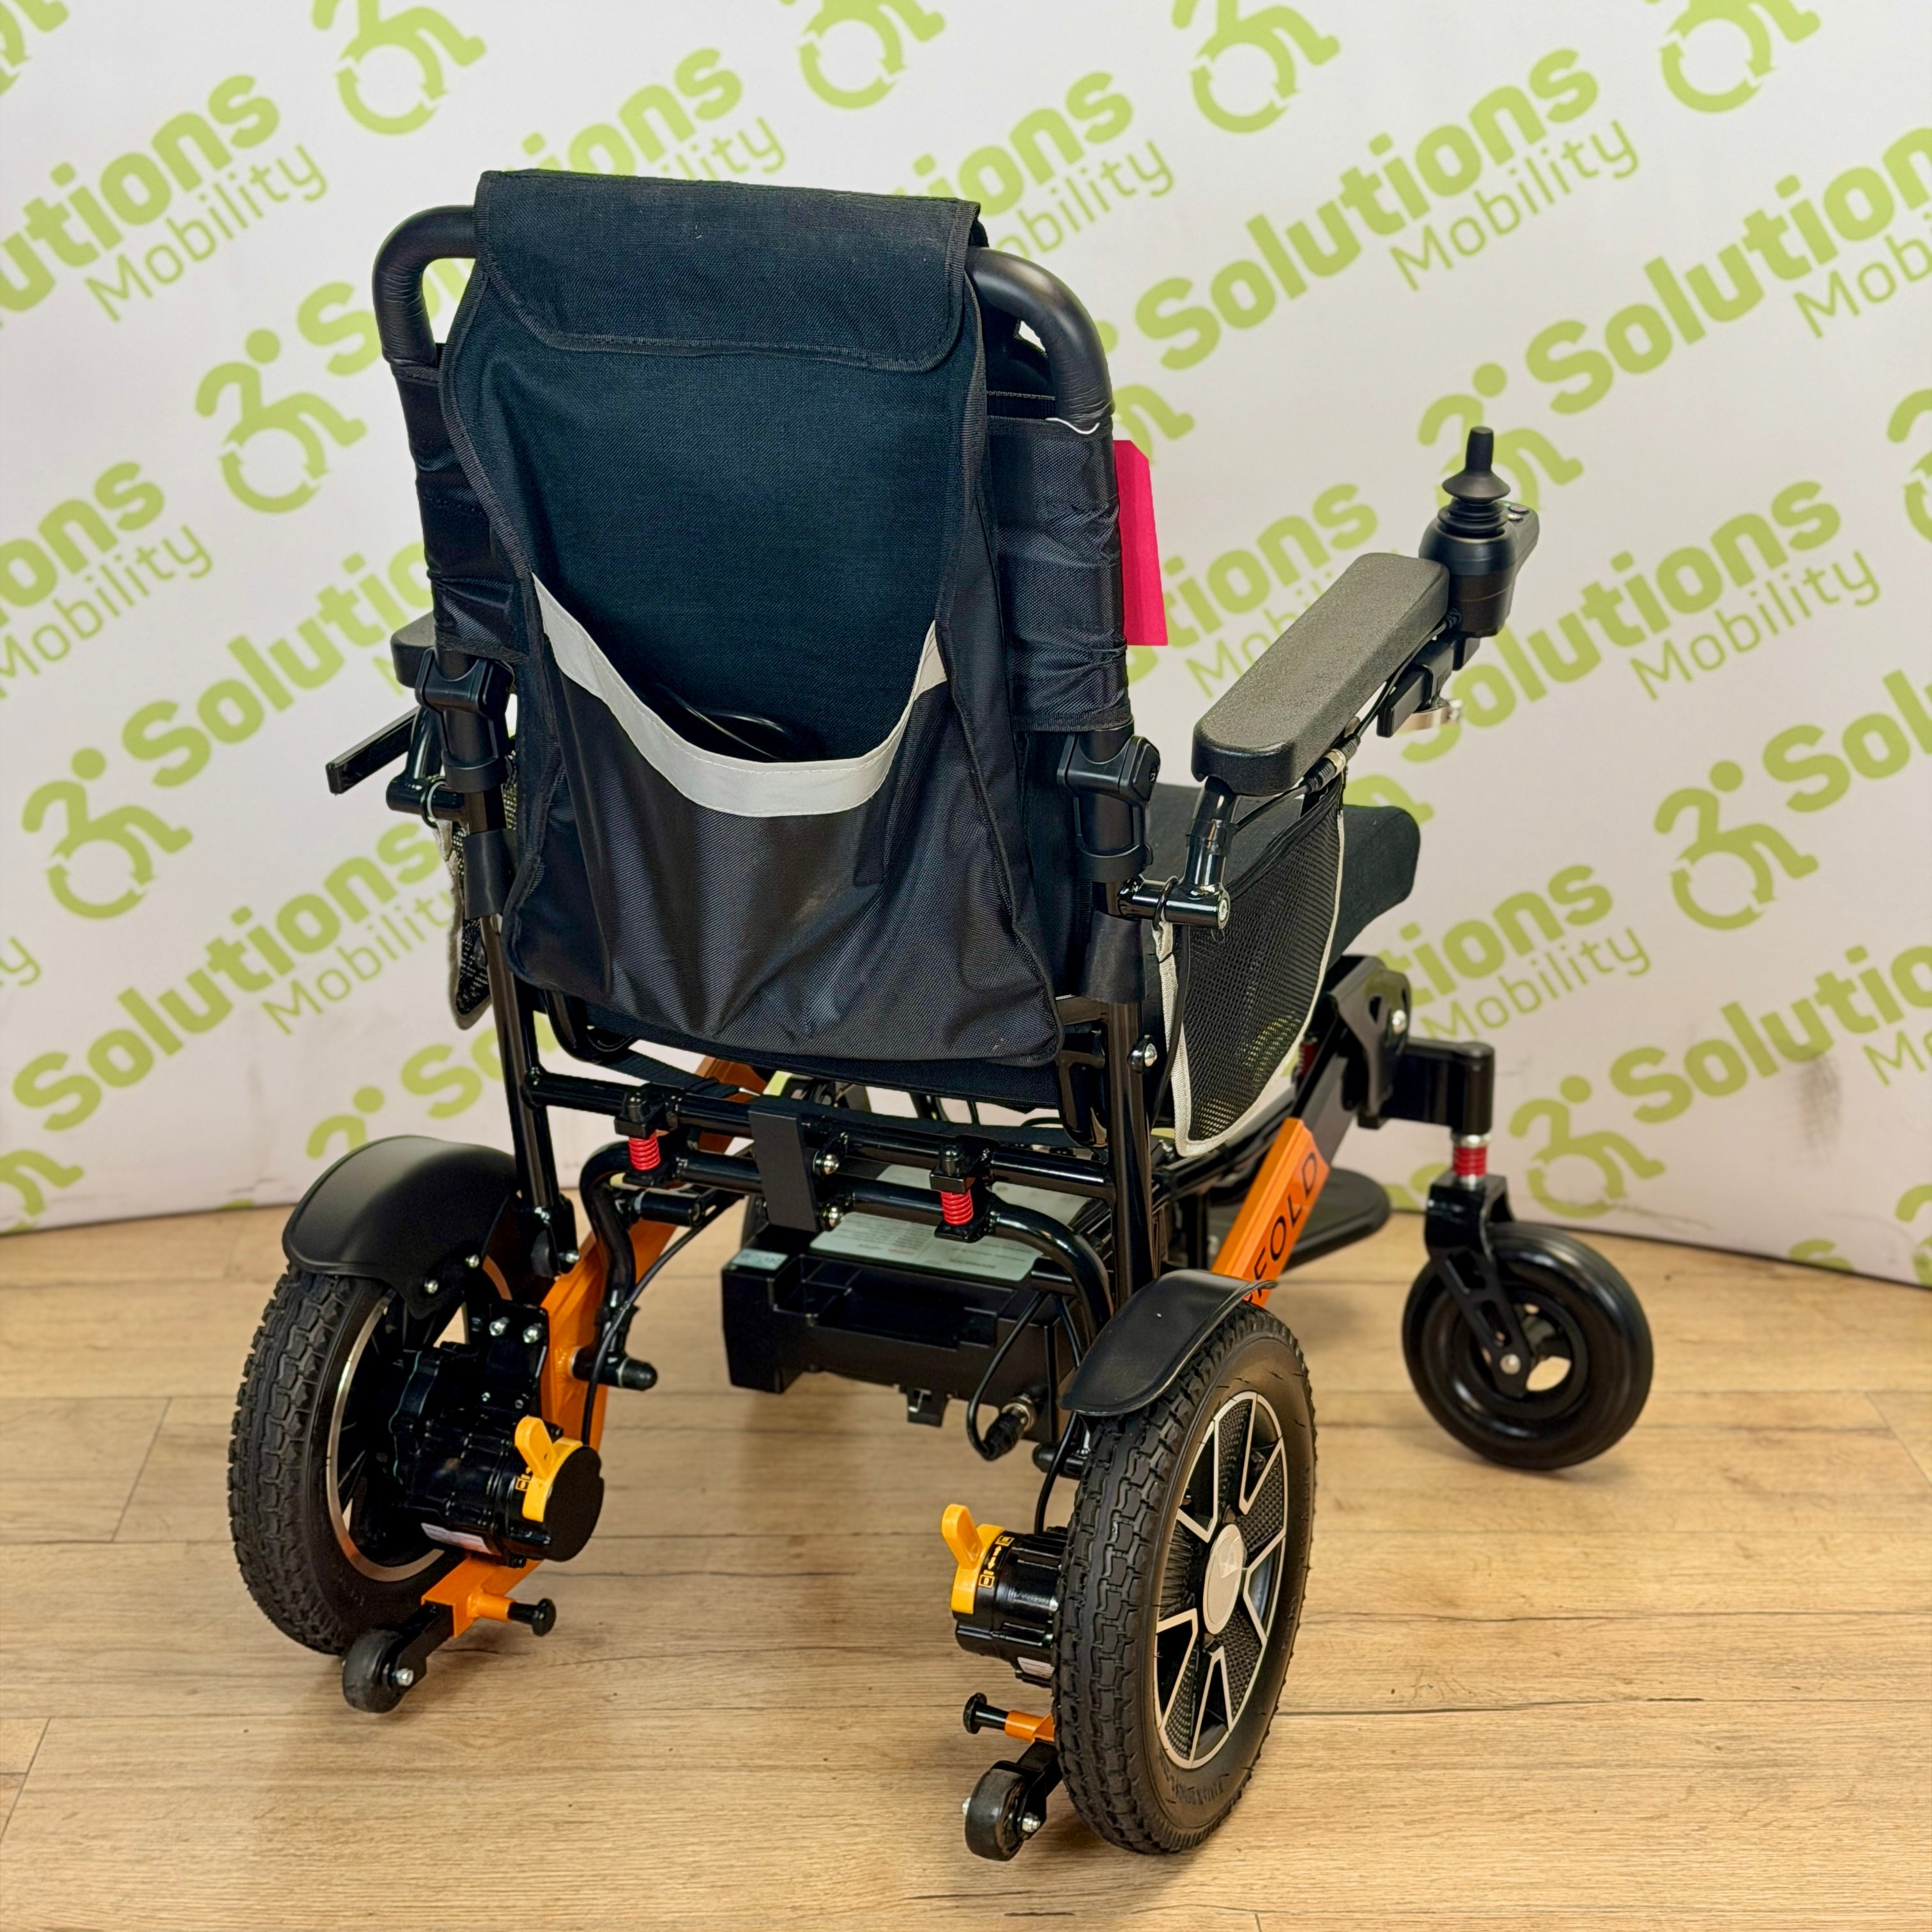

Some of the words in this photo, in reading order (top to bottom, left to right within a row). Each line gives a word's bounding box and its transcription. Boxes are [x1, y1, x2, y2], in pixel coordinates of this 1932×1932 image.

[84, 144, 328, 322] Mobility
[1133, 47, 1599, 372] Solutions
[1389, 119, 1639, 292] Mobility
[1524, 126, 1932, 416] Solution
[0, 462, 165, 627] ons
[1629, 550, 1881, 701] Mobility
[1761, 669, 1932, 814] Sol
[11, 822, 442, 1132] Solutions
[261, 891, 452, 1036] Mobilit
[1419, 928, 1652, 1041] Mobility
[1248, 1151, 1317, 1301] FOLD
